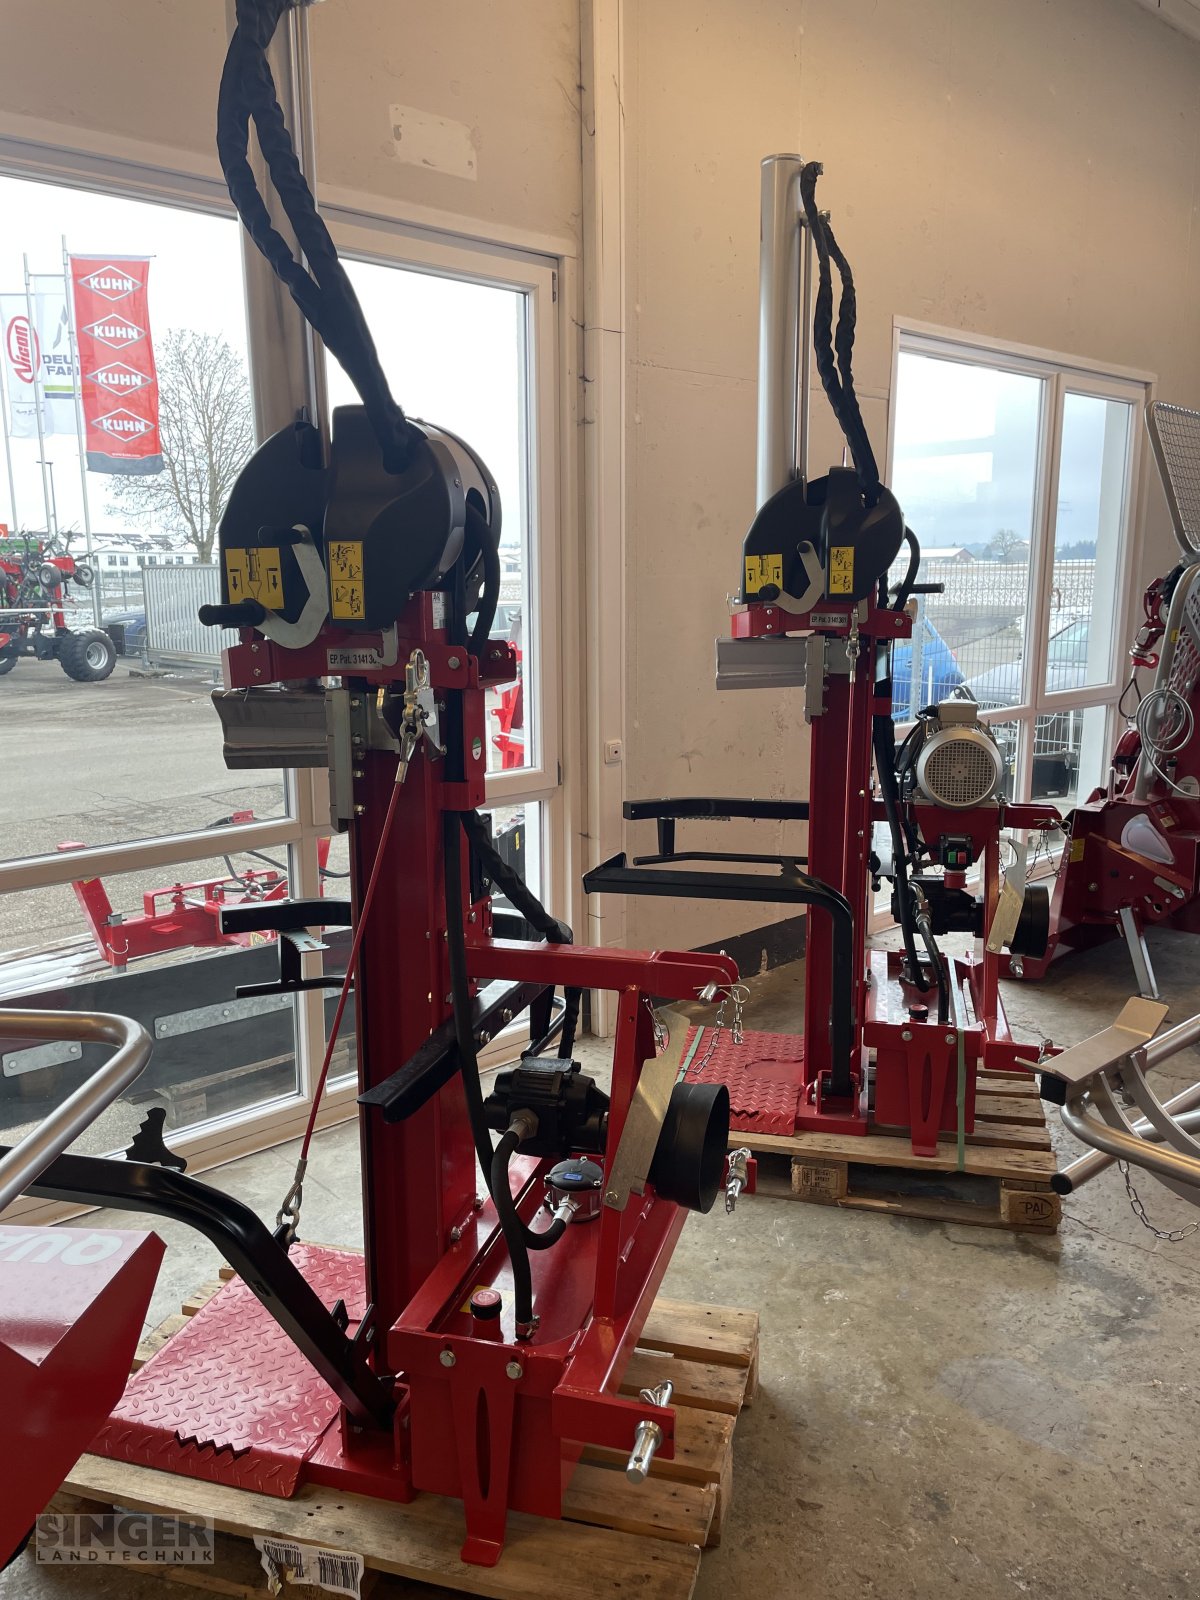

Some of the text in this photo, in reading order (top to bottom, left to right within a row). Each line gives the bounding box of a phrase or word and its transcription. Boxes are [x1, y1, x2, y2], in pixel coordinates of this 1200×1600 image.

[89, 277, 133, 291] KUHN
[93, 325, 138, 339] KUHN
[46, 365, 80, 376] FAH
[97, 372, 142, 386] KUHN
[102, 418, 147, 432] KUHN
[330, 654, 339, 664] EP.
